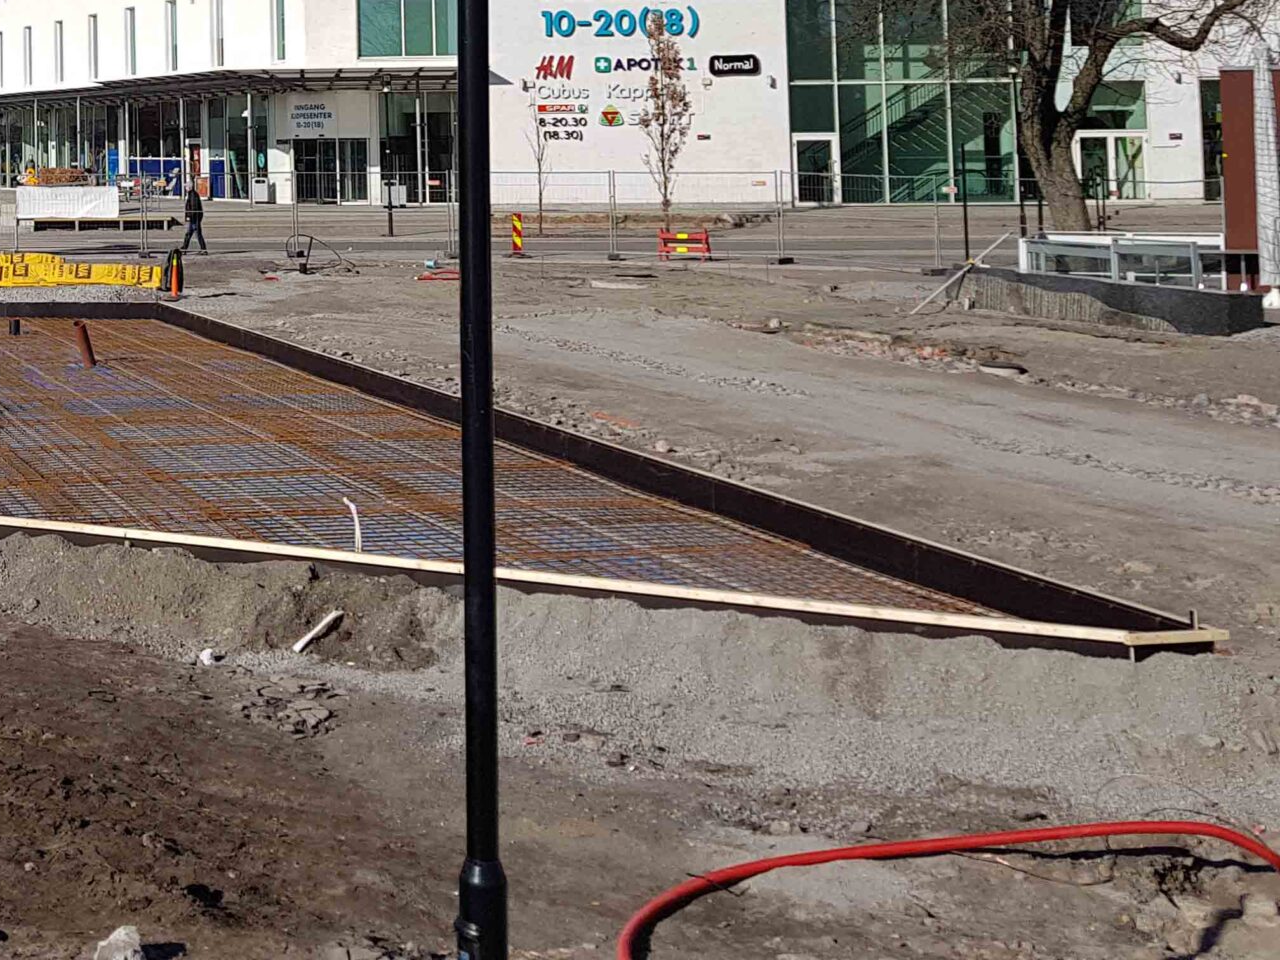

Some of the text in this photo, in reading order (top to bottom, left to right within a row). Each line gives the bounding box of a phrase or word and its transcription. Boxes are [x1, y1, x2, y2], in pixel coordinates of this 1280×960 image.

[613, 58, 684, 71] APOTK
[714, 58, 754, 70] Normal
[538, 83, 590, 100] Cubus
[538, 117, 588, 127] 8-20.30
